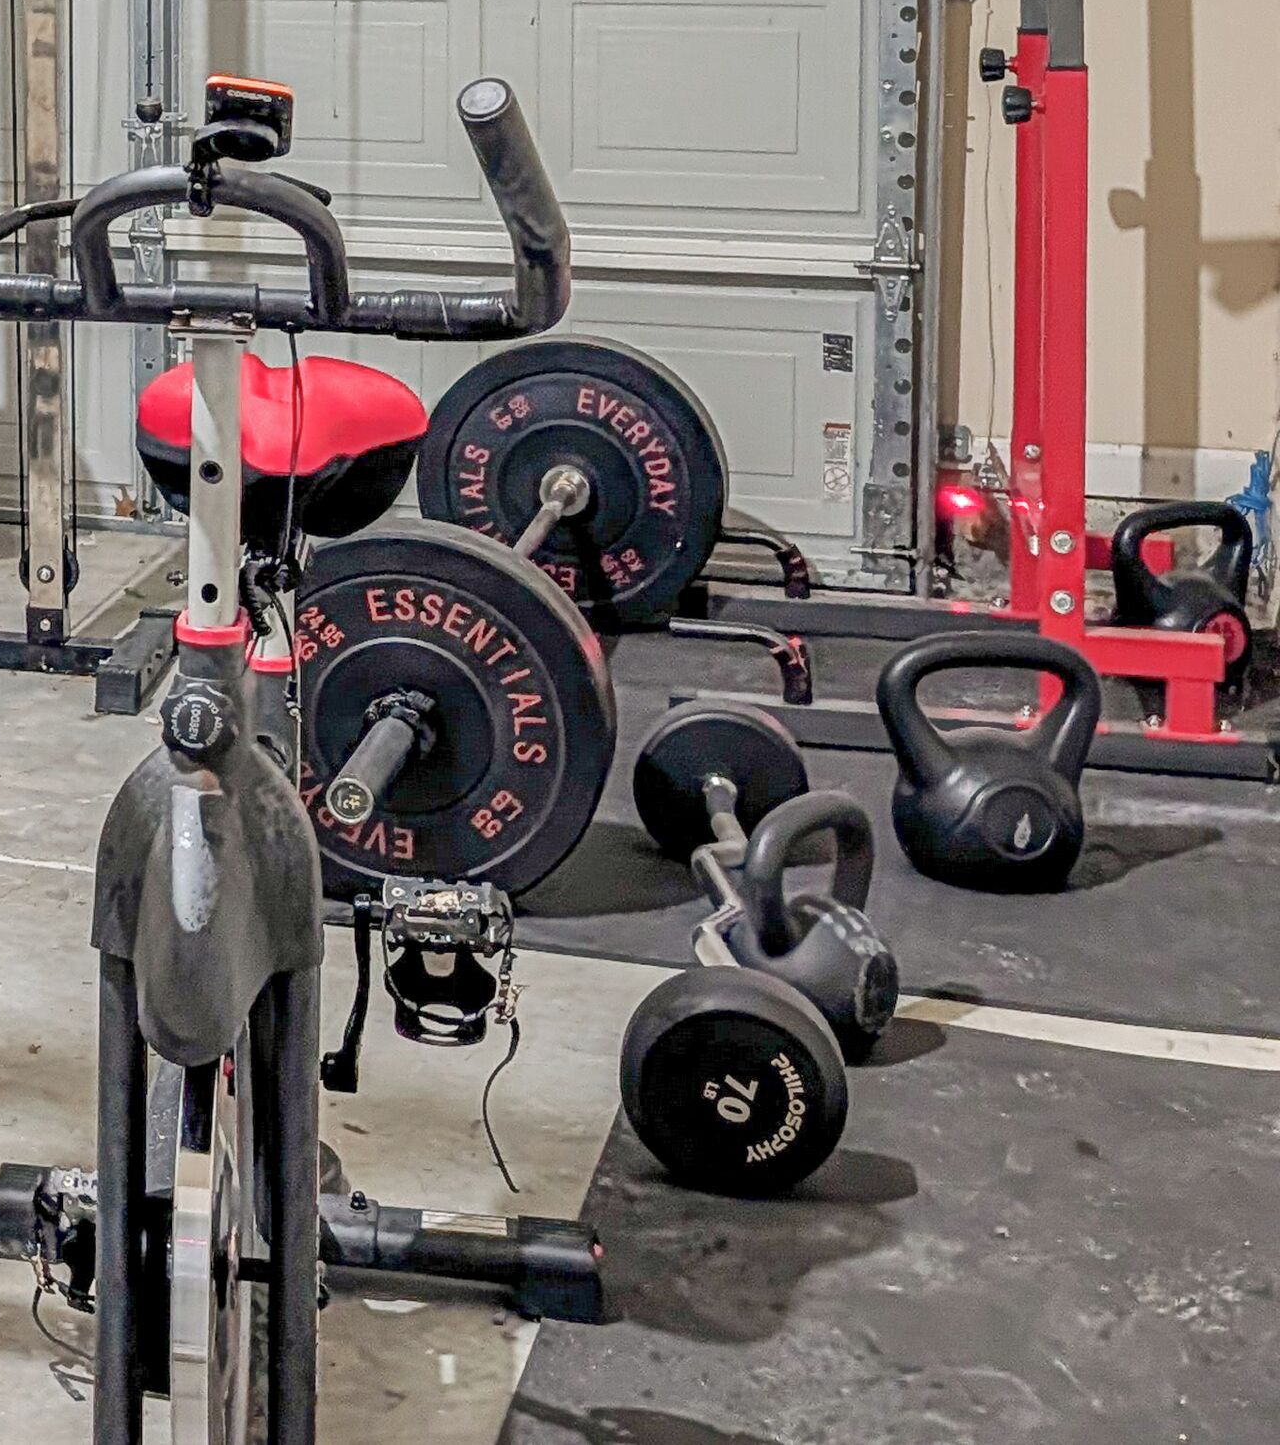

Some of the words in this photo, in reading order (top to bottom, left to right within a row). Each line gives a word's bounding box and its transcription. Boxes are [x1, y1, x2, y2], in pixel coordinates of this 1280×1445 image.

[577, 388, 676, 517] EVERYDAY
[299, 606, 346, 648] 24.95
[365, 587, 548, 765] ESSENTIALS
[188, 704, 202, 740] LOOSEN
[491, 790, 524, 821] LB
[703, 1081, 720, 1100] LB
[717, 1074, 759, 1123] 70
[746, 1052, 806, 1163] PHILOSOPHY
